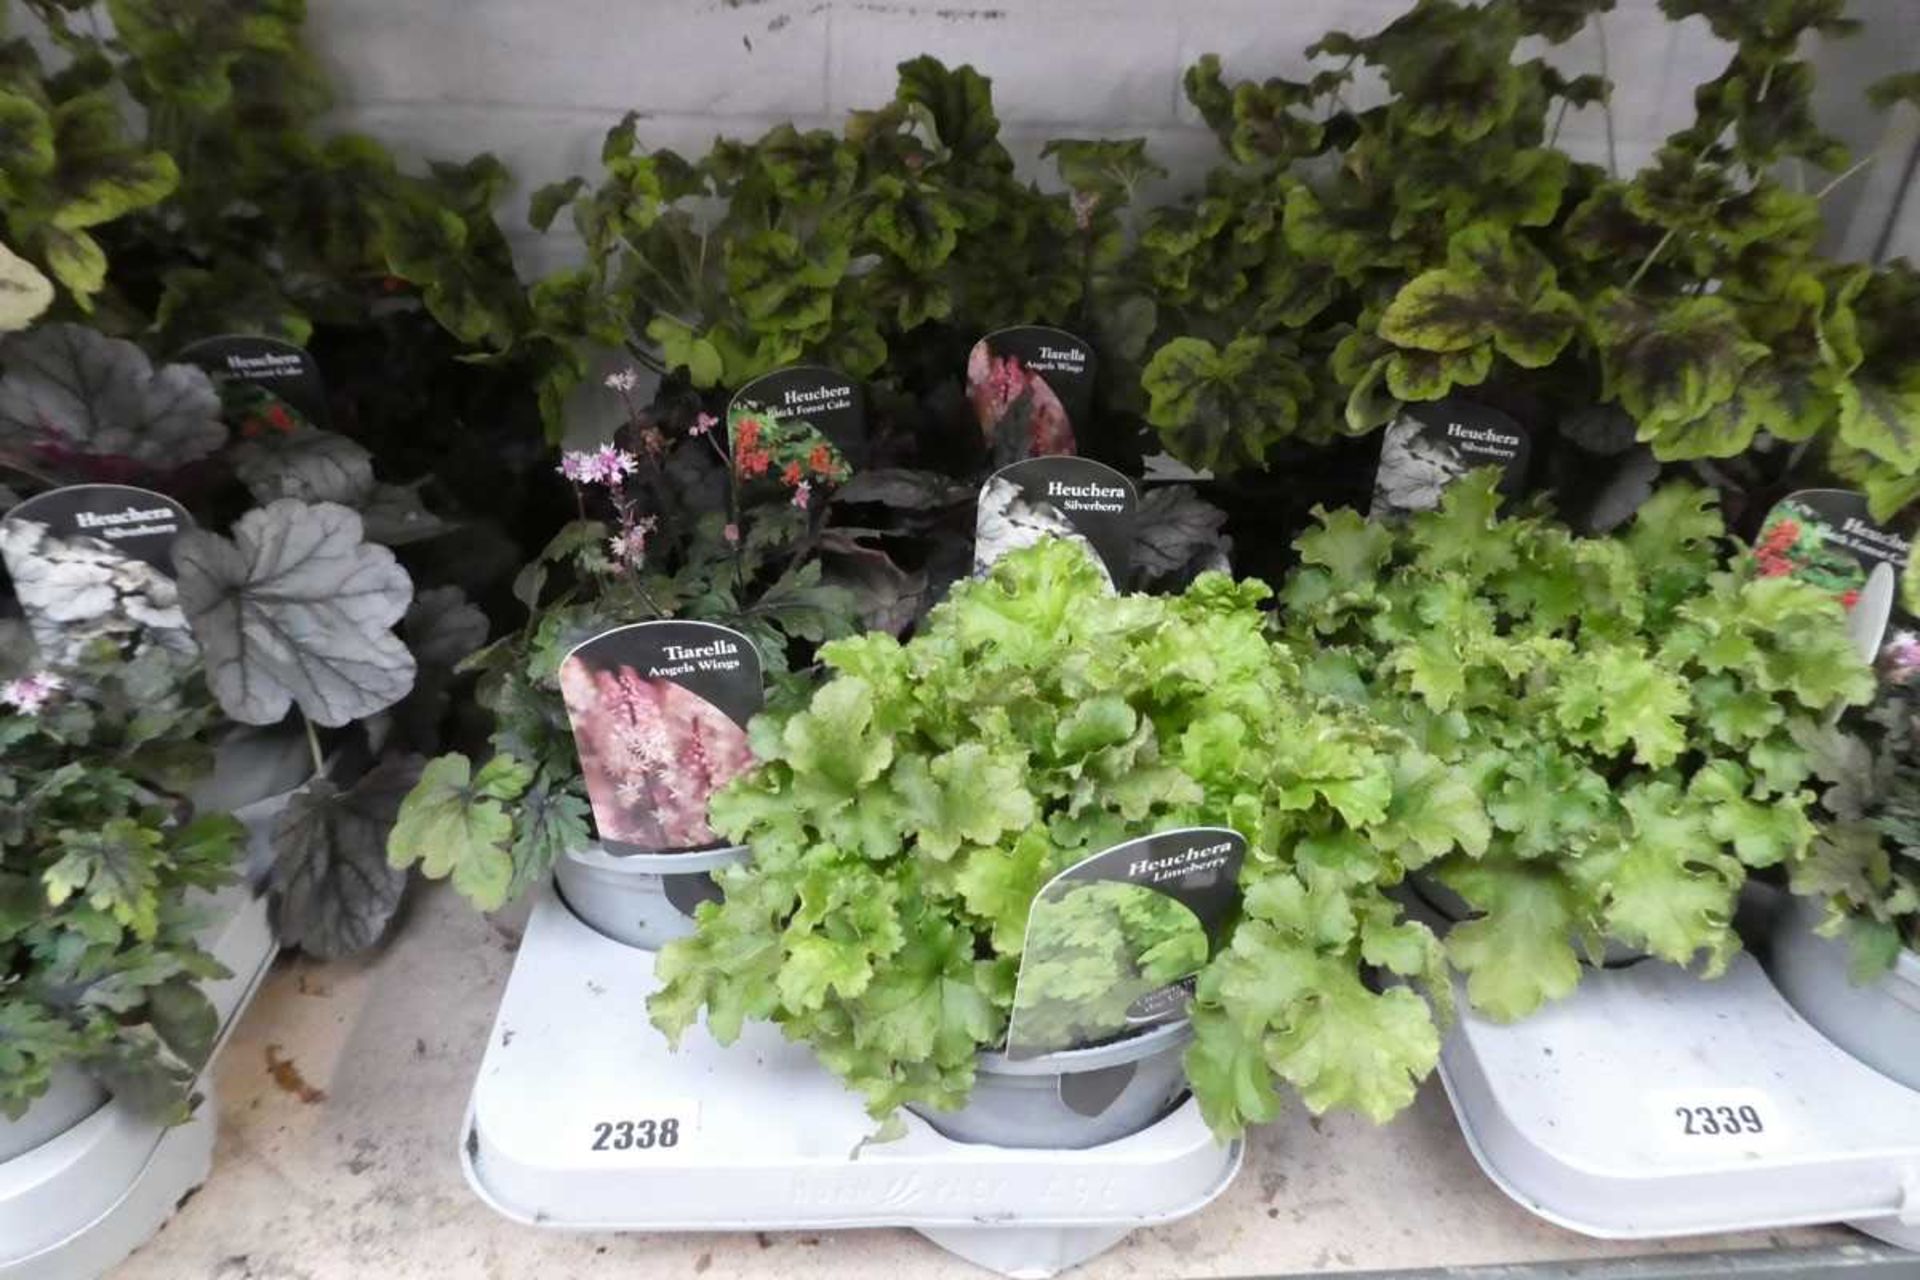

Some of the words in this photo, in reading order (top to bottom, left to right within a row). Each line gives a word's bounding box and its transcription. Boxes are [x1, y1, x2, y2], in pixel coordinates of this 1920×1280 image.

[1039, 346, 1085, 361] Tiarella
[784, 386, 850, 404] Heuchera
[1447, 423, 1519, 446] Heuchera
[1048, 482, 1125, 498] Heuchera
[1064, 499, 1124, 514] Silverberry
[662, 640, 738, 661] Tiarella
[648, 661, 695, 678] Angels
[697, 659, 740, 672] Wings
[1129, 841, 1232, 878] Heuchera
[1153, 857, 1228, 883] Limeberry
[1675, 1105, 1764, 1136] 2339
[591, 1118, 680, 1151] 2338
